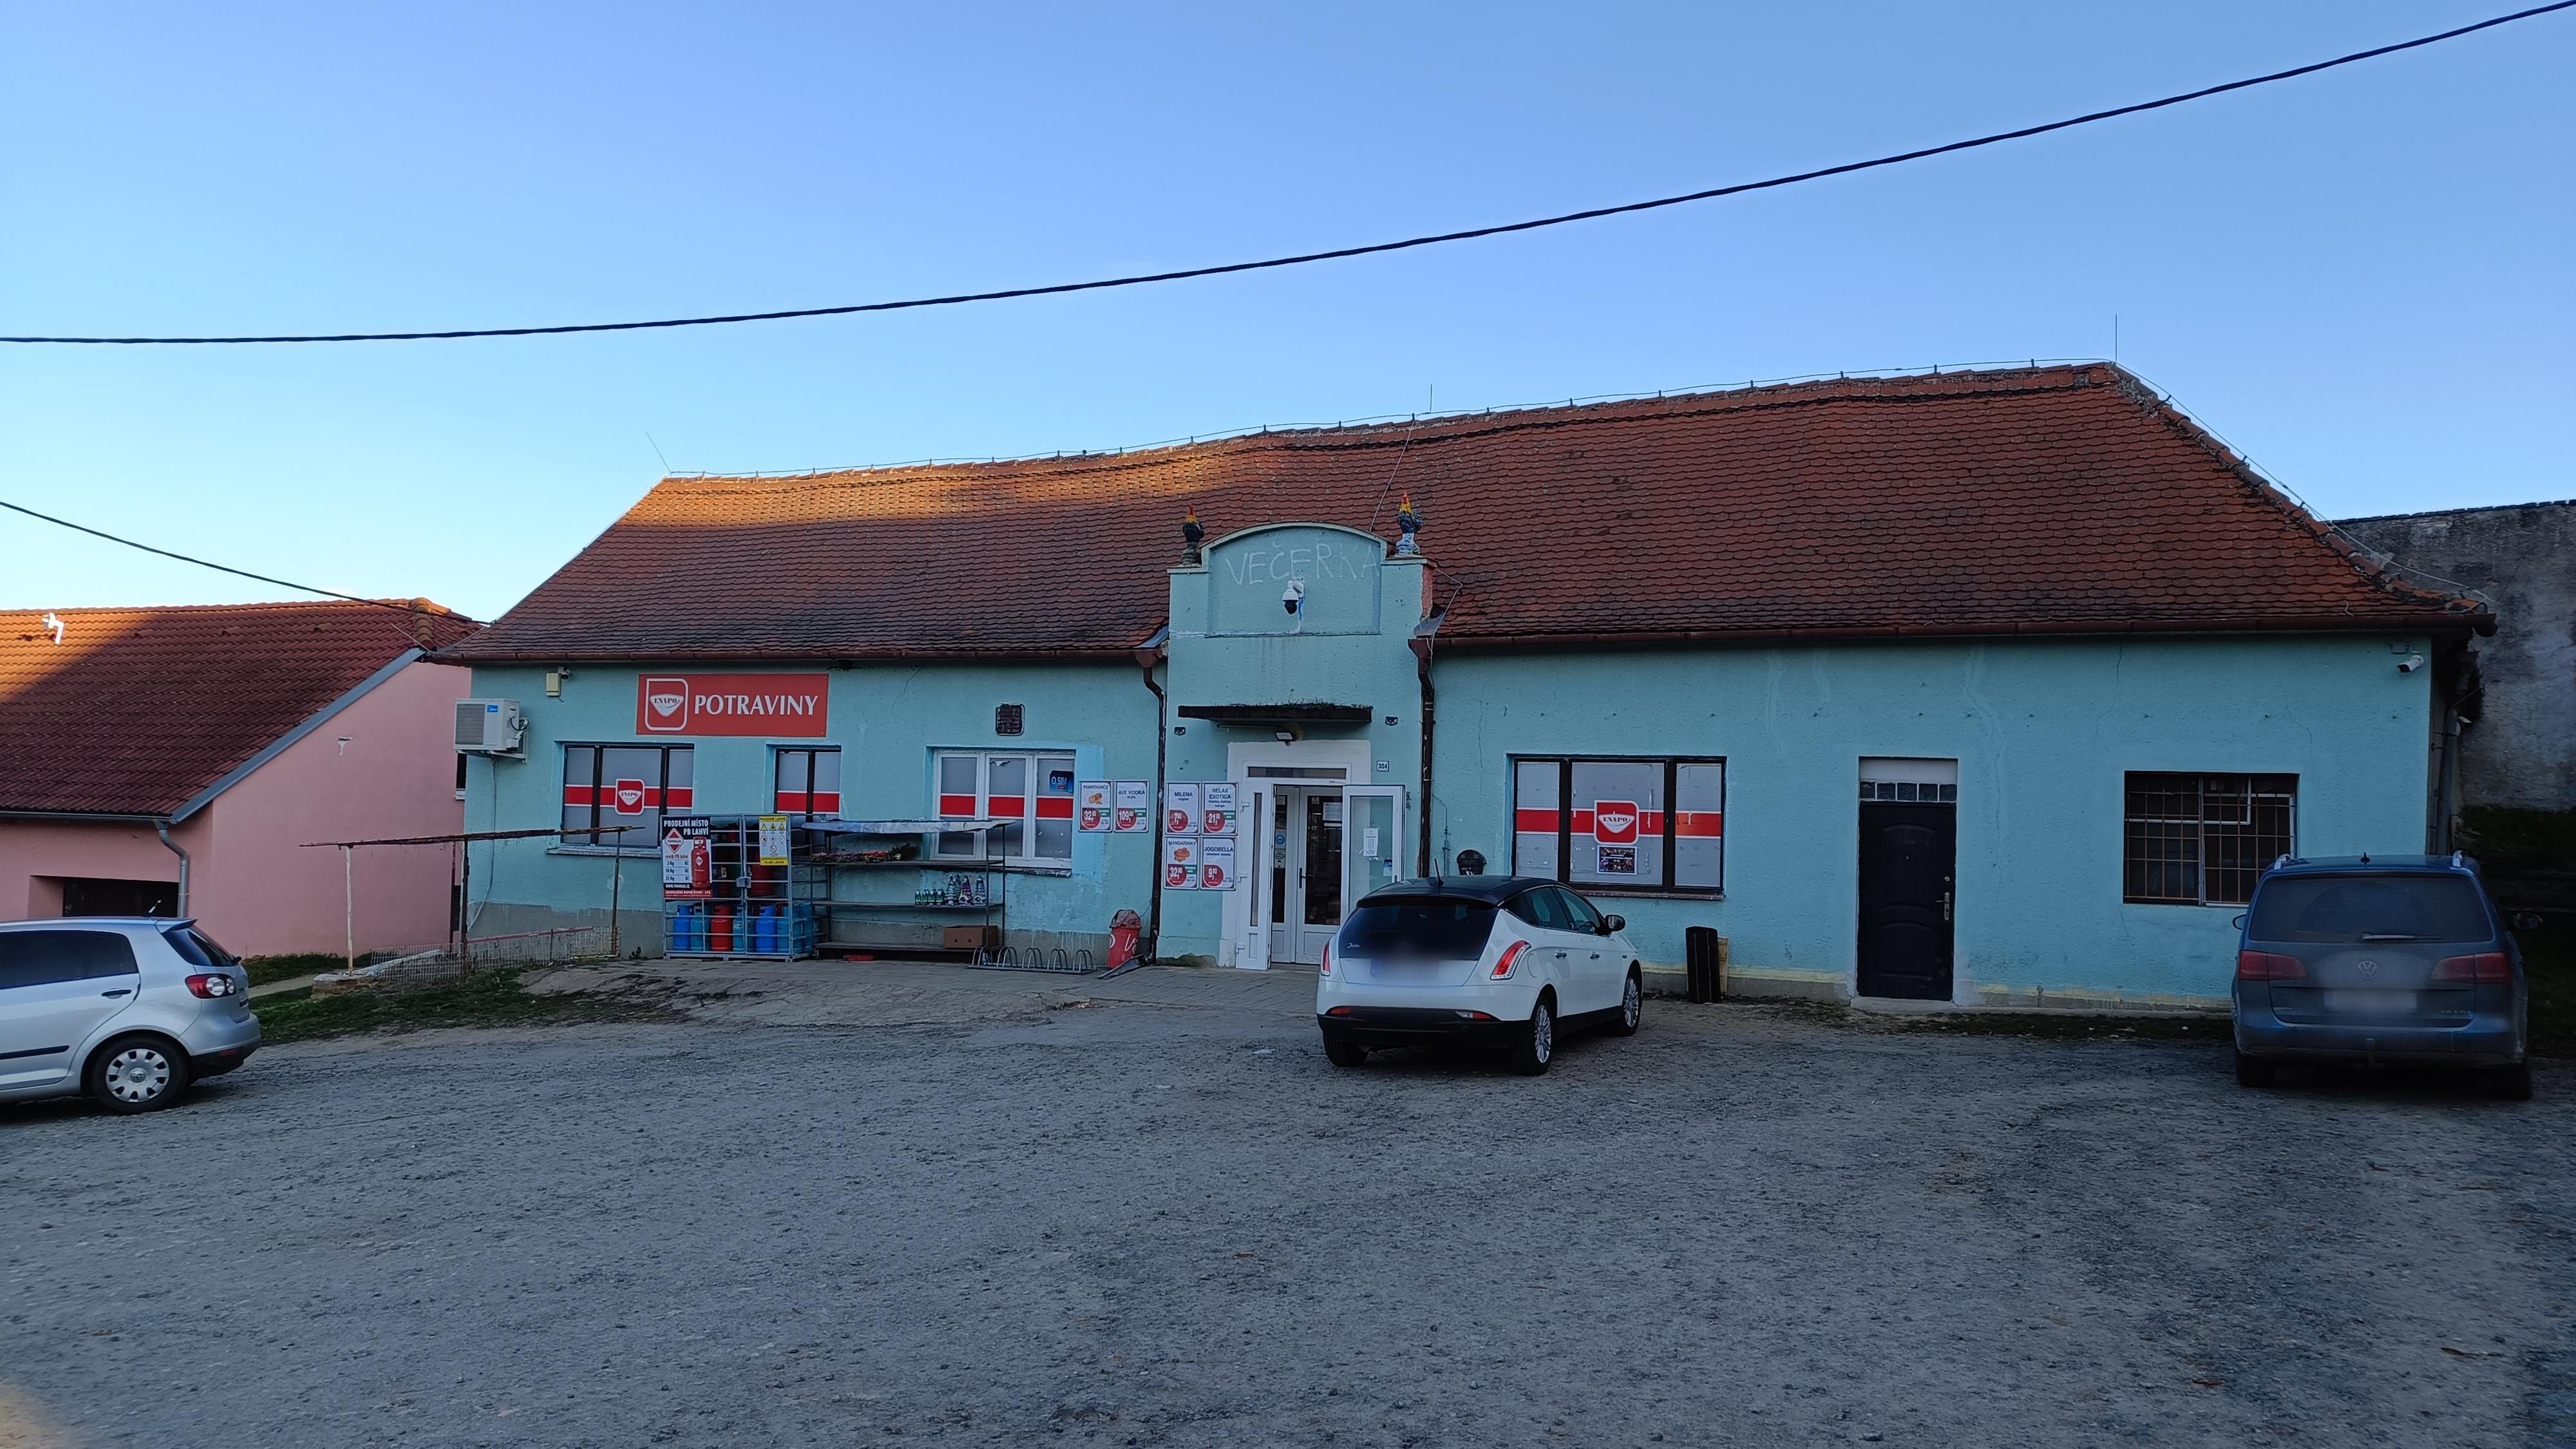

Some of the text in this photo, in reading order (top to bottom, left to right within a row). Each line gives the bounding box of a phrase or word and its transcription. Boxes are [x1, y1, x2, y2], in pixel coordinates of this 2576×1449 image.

[694, 694, 819, 715] POTRAVINY
[663, 819, 709, 827] PRODEJNÍ MÍSTO
[692, 827, 709, 835] LAHVÍ
